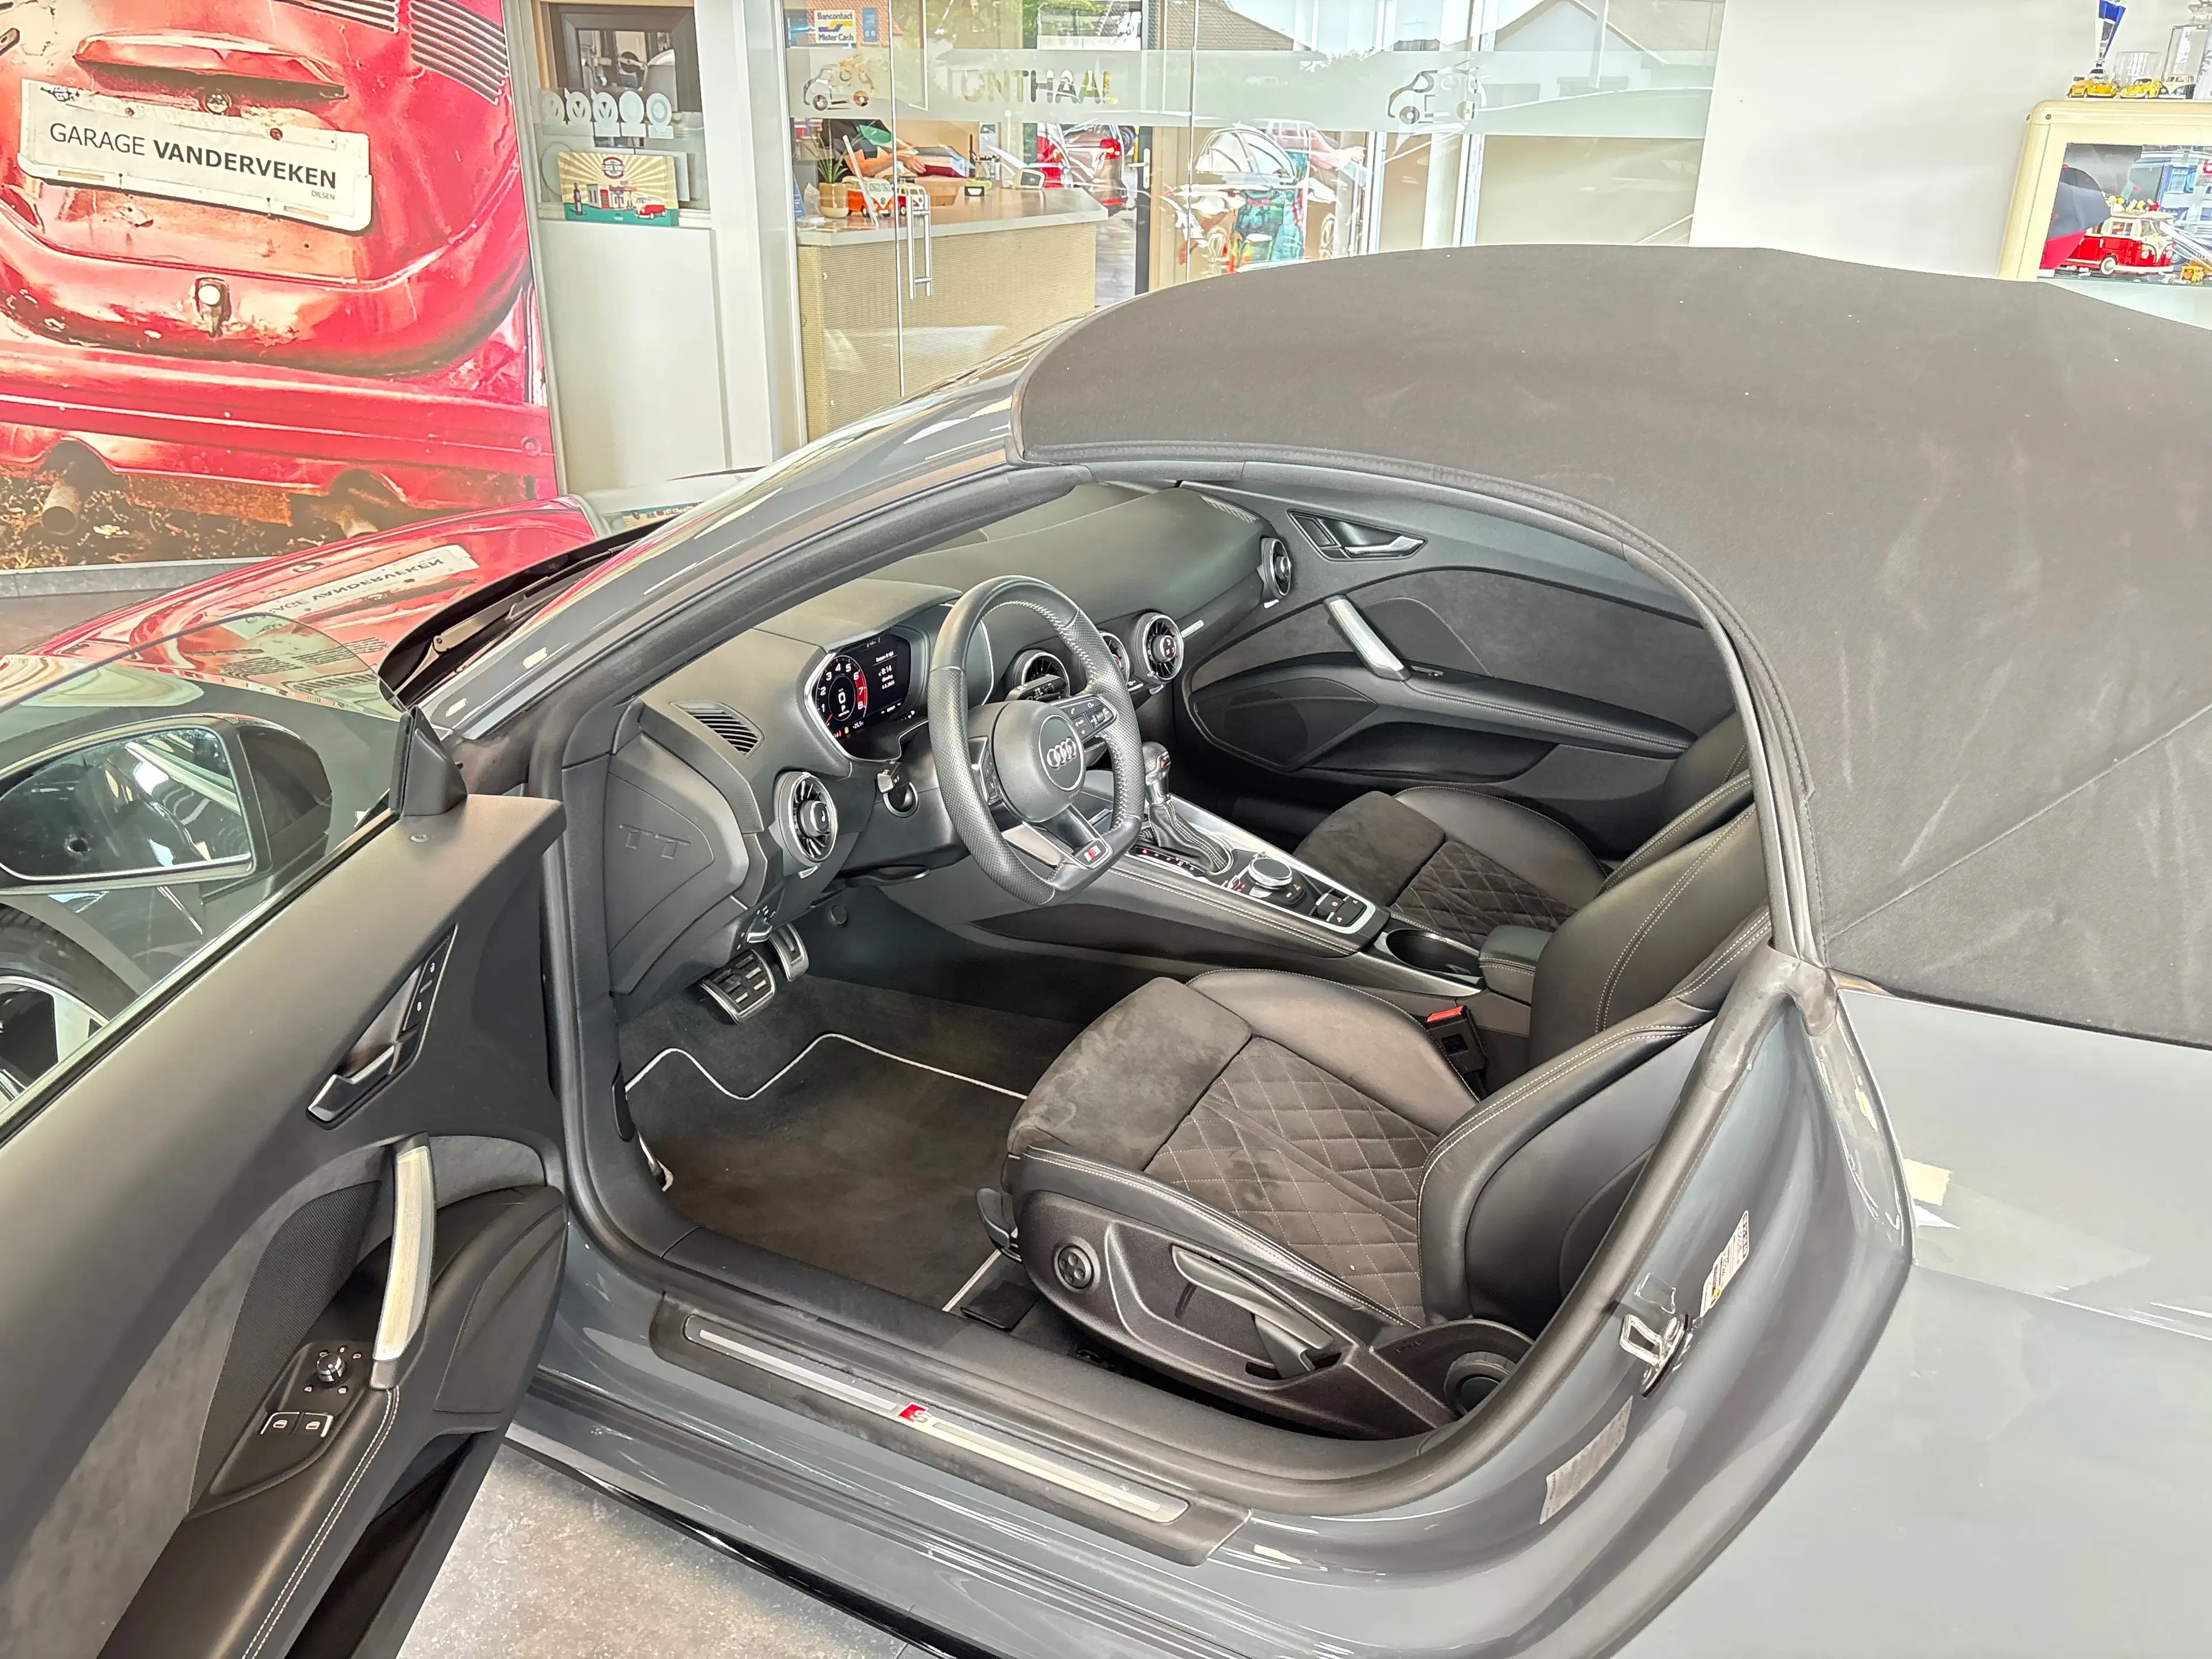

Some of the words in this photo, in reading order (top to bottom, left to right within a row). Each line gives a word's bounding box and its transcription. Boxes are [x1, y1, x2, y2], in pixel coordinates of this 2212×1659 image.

[960, 69, 1119, 104] ONTHAAL
[50, 123, 145, 156] GARAGE
[152, 139, 336, 189] VANDERVEKEN
[311, 190, 335, 200] DILSEN
[835, 663, 841, 672] 4
[845, 663, 851, 672] 5
[826, 671, 832, 681] 3
[853, 671, 859, 680] 6
[820, 686, 826, 696] 2
[858, 686, 863, 696] 7
[838, 692, 846, 704] 0
[821, 703, 825, 713] 1
[857, 701, 863, 710] 8
[619, 823, 691, 859] TT
